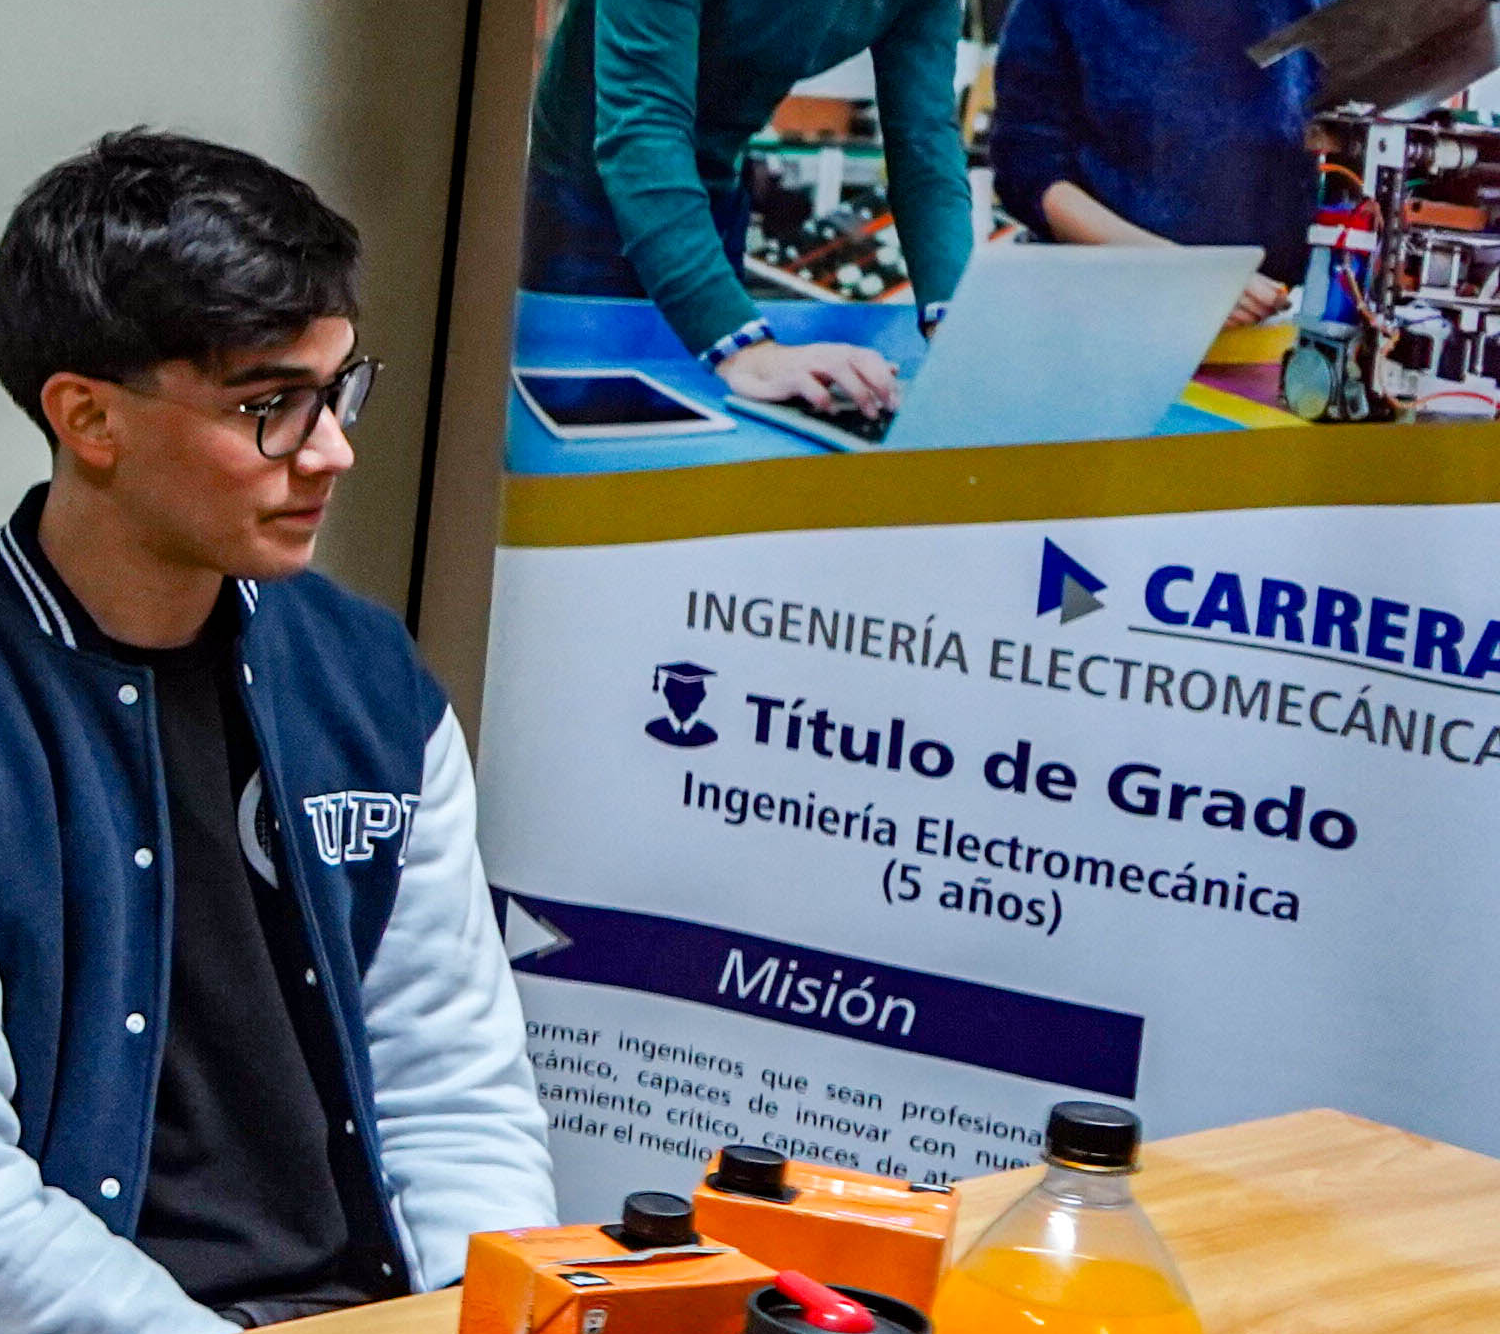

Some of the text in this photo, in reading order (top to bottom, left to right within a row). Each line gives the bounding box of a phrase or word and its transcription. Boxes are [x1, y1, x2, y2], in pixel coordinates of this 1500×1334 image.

[686, 590, 1500, 766] INGENIERÍA ELECTROMECÁNICA
[746, 693, 1358, 851] Título de Grado
[683, 770, 1300, 922] Ingeniería Electromecánica
[882, 858, 1062, 936] (5 años)
[717, 948, 917, 1037] Misión
[526, 1020, 1042, 1148] ormar ingenieros que sean profesiona
[528, 1050, 1030, 1172] cánico, capaces de innovar con nue
[538, 1082, 651, 1118] samiento
[666, 1105, 745, 1144] crítico,
[762, 1130, 860, 1169] capaces
[876, 1153, 908, 1180] de
[548, 1110, 713, 1164] uidar el medio
